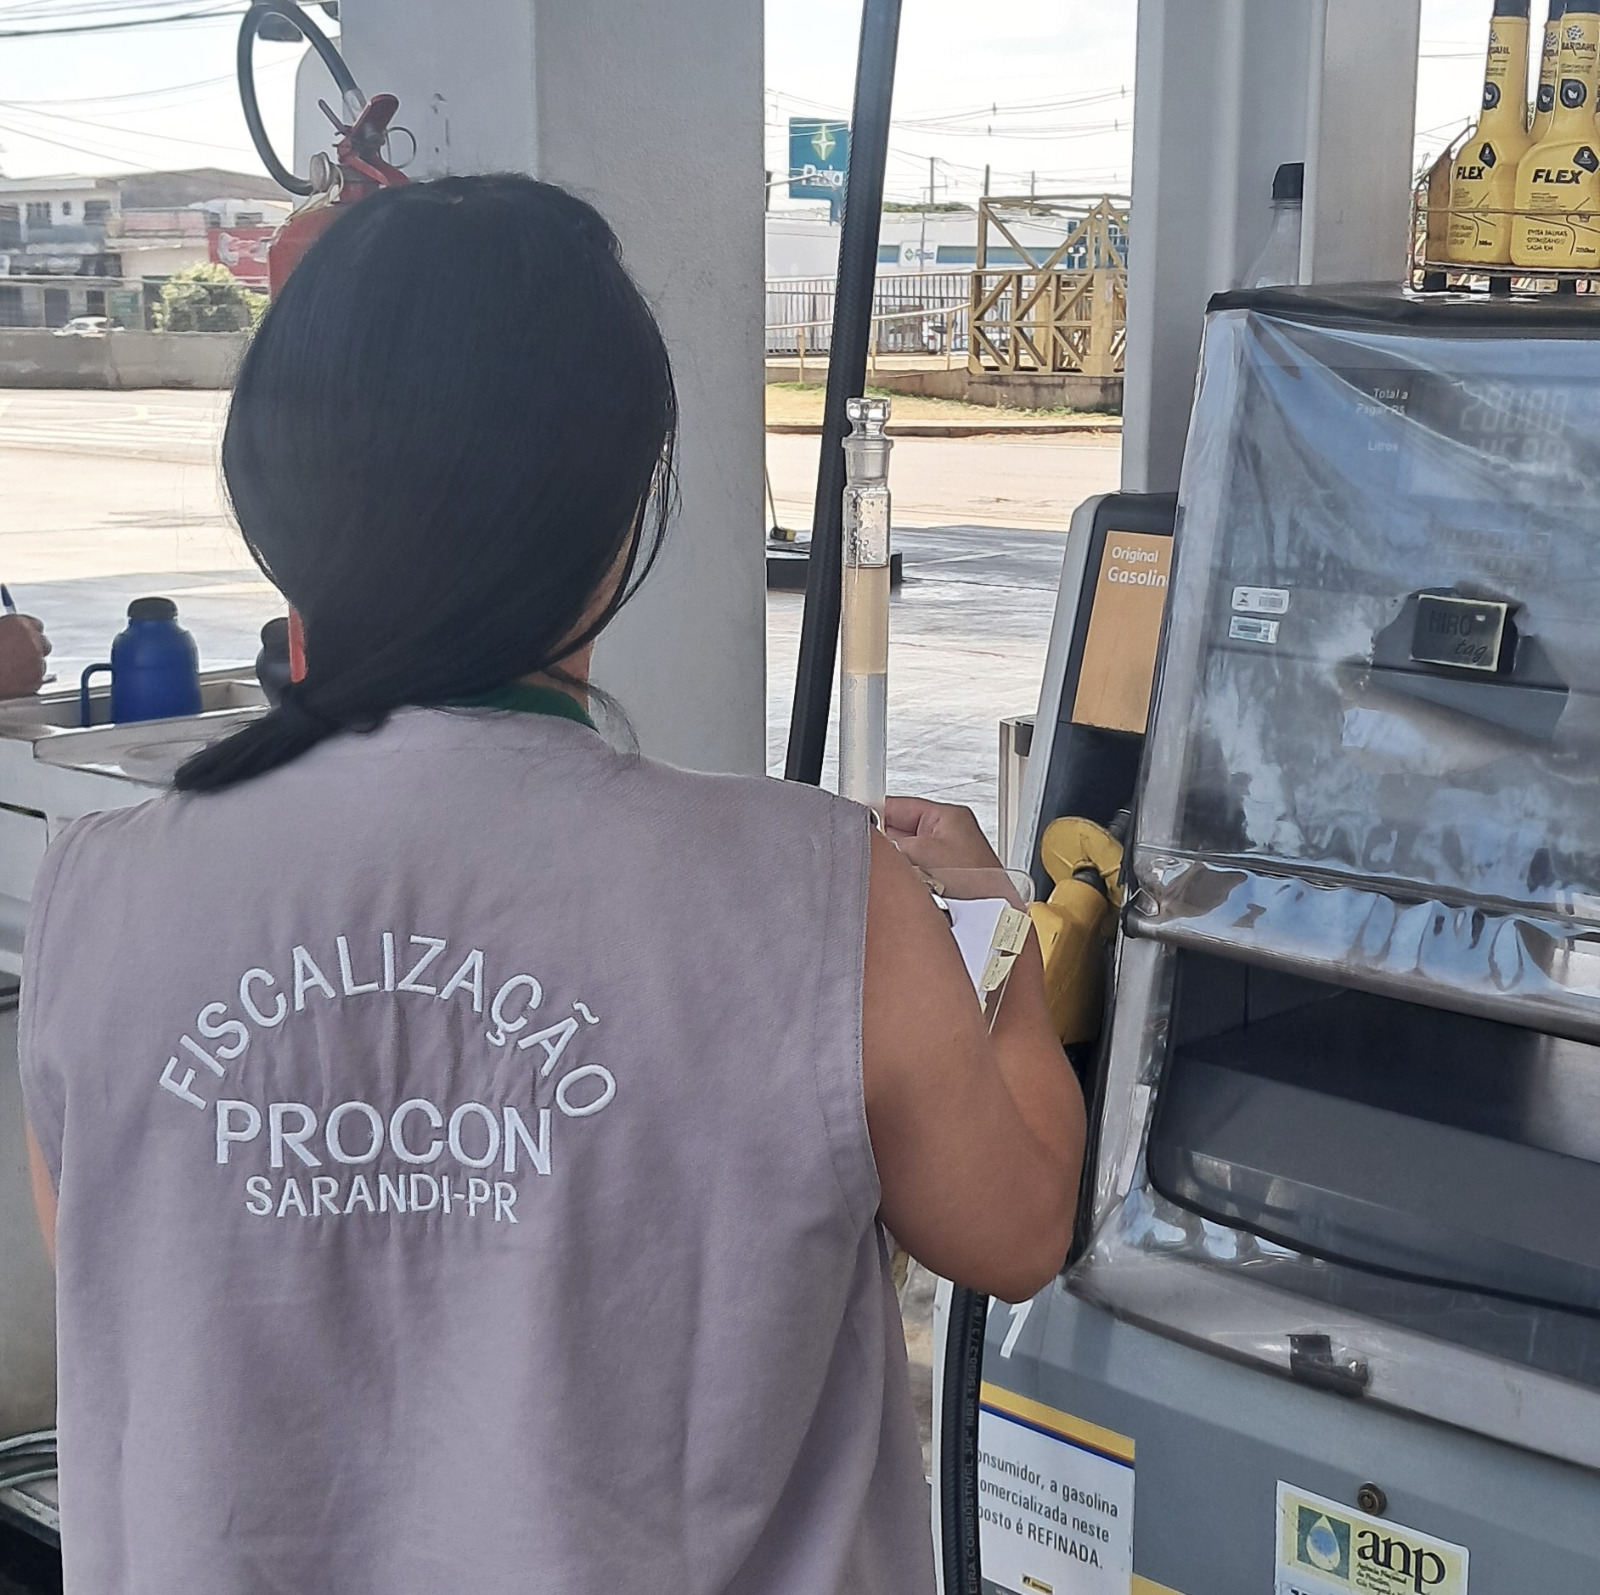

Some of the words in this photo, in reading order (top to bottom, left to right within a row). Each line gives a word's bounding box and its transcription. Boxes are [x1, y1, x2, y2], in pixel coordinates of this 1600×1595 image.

[1456, 166, 1485, 180] FLEX
[1532, 169, 1583, 184] FLEX
[1374, 387, 1400, 399] Total
[1107, 566, 1167, 587] Gasolin
[1111, 546, 1159, 564] Original
[1455, 639, 1488, 664] tag
[158, 932, 617, 1119] FISCALIZAÇÃO
[216, 1099, 552, 1176] PROCON
[245, 1173, 519, 1225] SARANDI-PR
[978, 1450, 1044, 1490] onsumidor,
[1050, 1480, 1058, 1493] a
[1062, 1485, 1118, 1518] gasolina
[980, 1479, 1067, 1525] omercializada
[1072, 1516, 1109, 1543] neste
[1016, 1518, 1023, 1535] é
[1028, 1522, 1103, 1570] REFINADA.
[1357, 1530, 1446, 1595] anp
